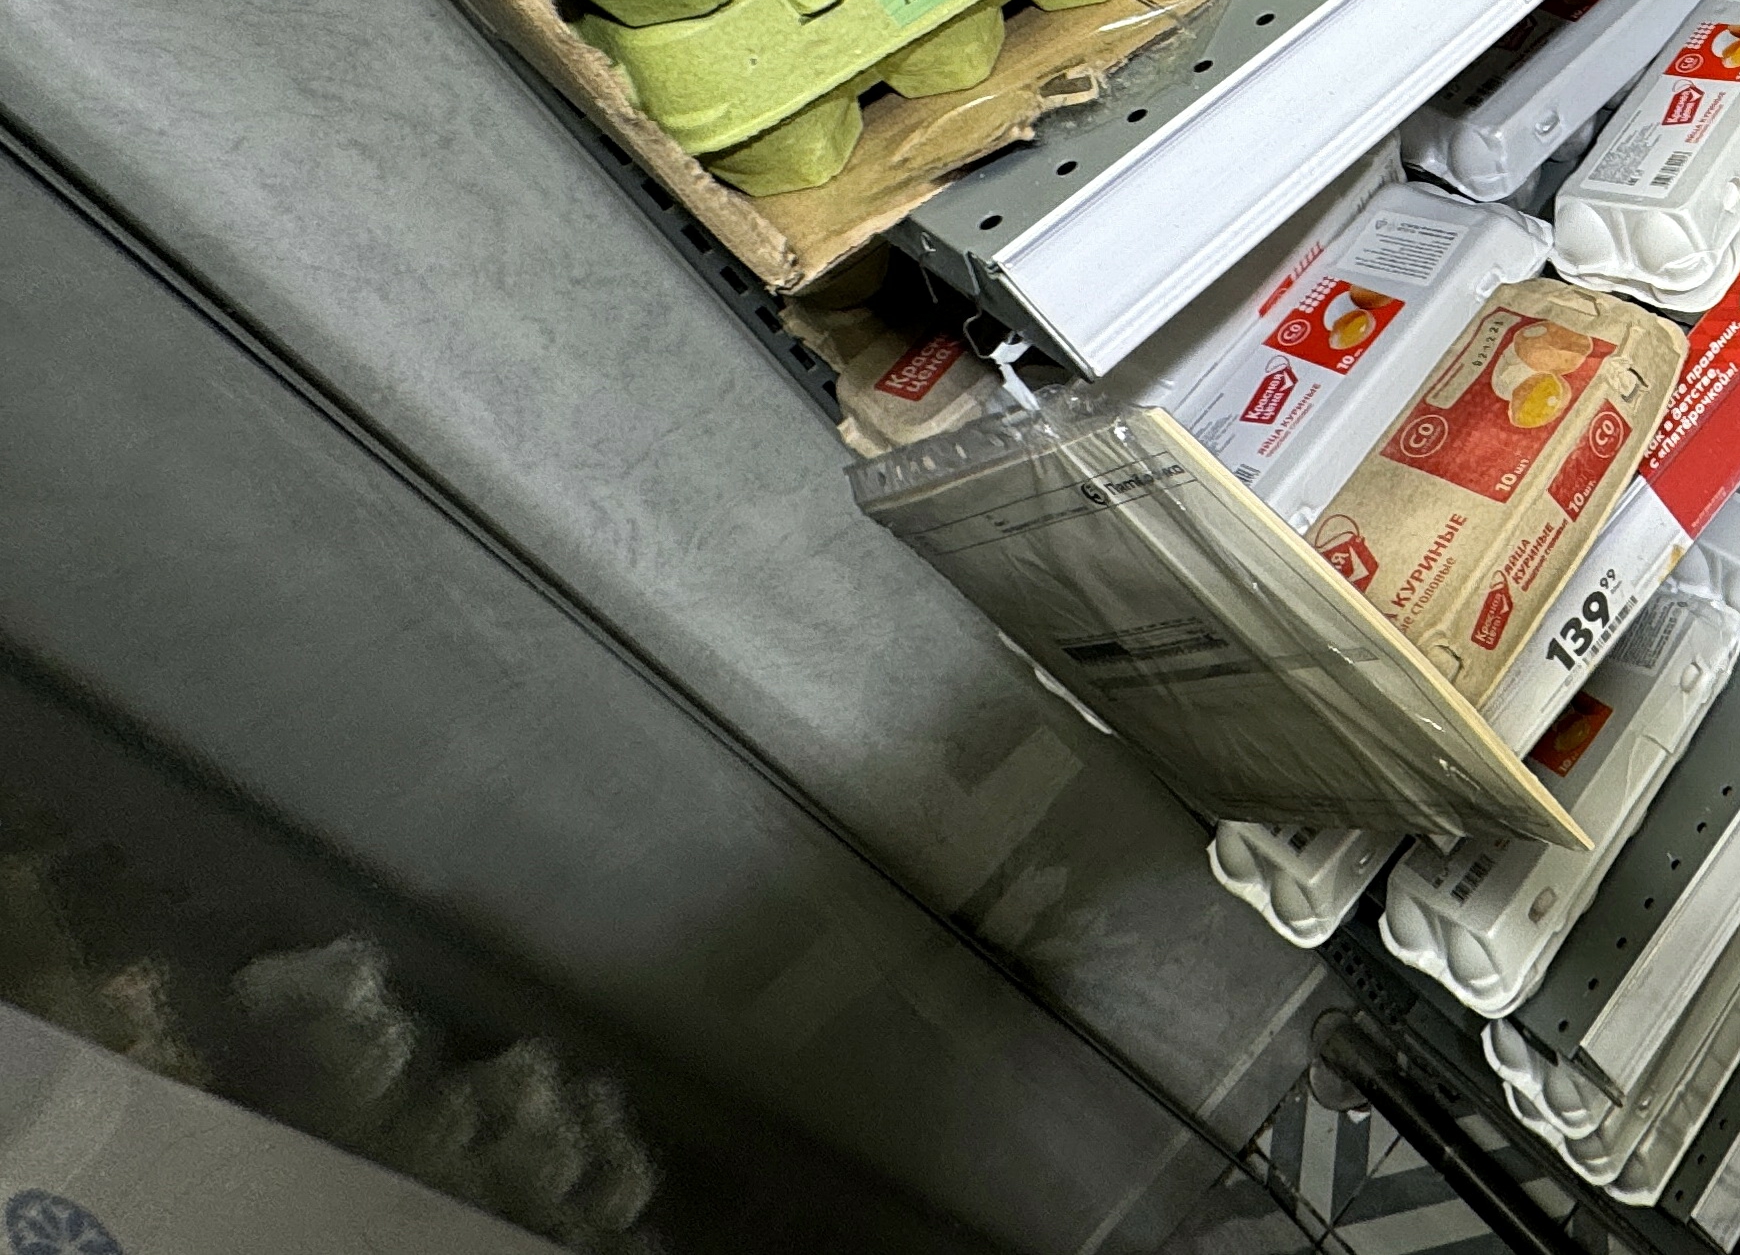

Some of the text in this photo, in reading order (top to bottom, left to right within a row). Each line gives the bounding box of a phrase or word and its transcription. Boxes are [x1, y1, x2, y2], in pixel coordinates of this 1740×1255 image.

[1246, 370, 1284, 419] Красная
[1280, 383, 1322, 429] КУРИНЫЕ
[1671, 368, 1721, 421] детстве,
[1495, 473, 1518, 492] 10
[1568, 492, 1586, 513] 10
[1391, 513, 1468, 608] КУРИНЫЕ
[1504, 539, 1531, 577] ЯЙЦА
[1511, 521, 1554, 585] КУРИНЫЕ
[1411, 556, 1457, 616] столовые
[1546, 569, 1616, 671] 139 99
